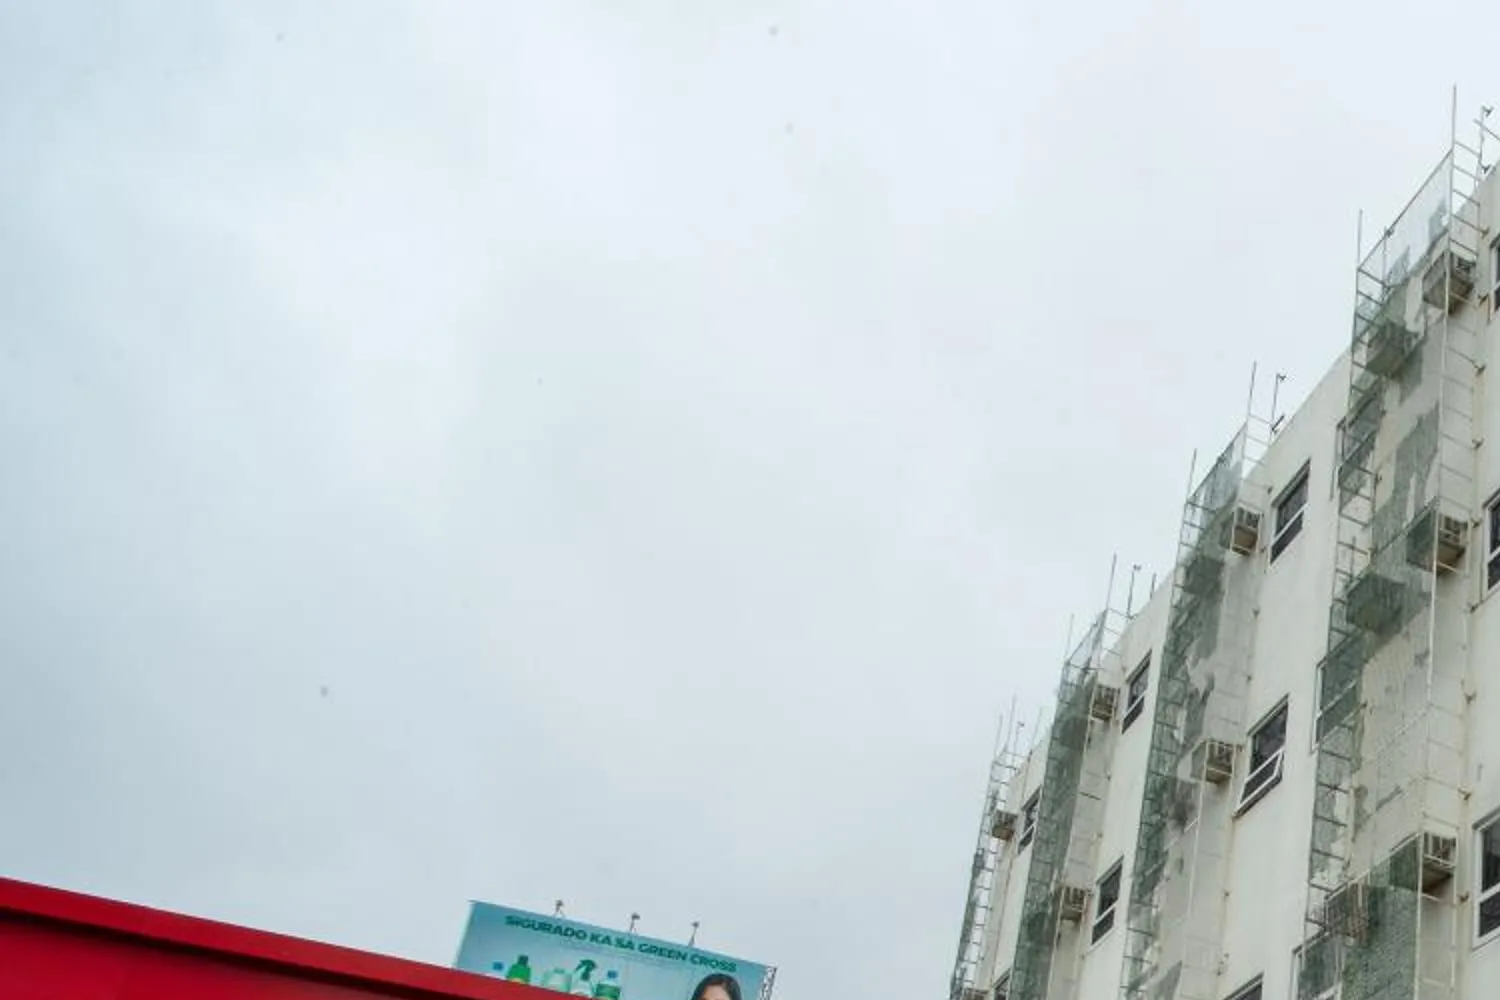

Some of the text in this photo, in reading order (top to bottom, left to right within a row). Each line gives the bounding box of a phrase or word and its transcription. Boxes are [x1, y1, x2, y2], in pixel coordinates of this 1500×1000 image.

[504, 914, 737, 972] SIGURADO KA SA GREEN CROSS
